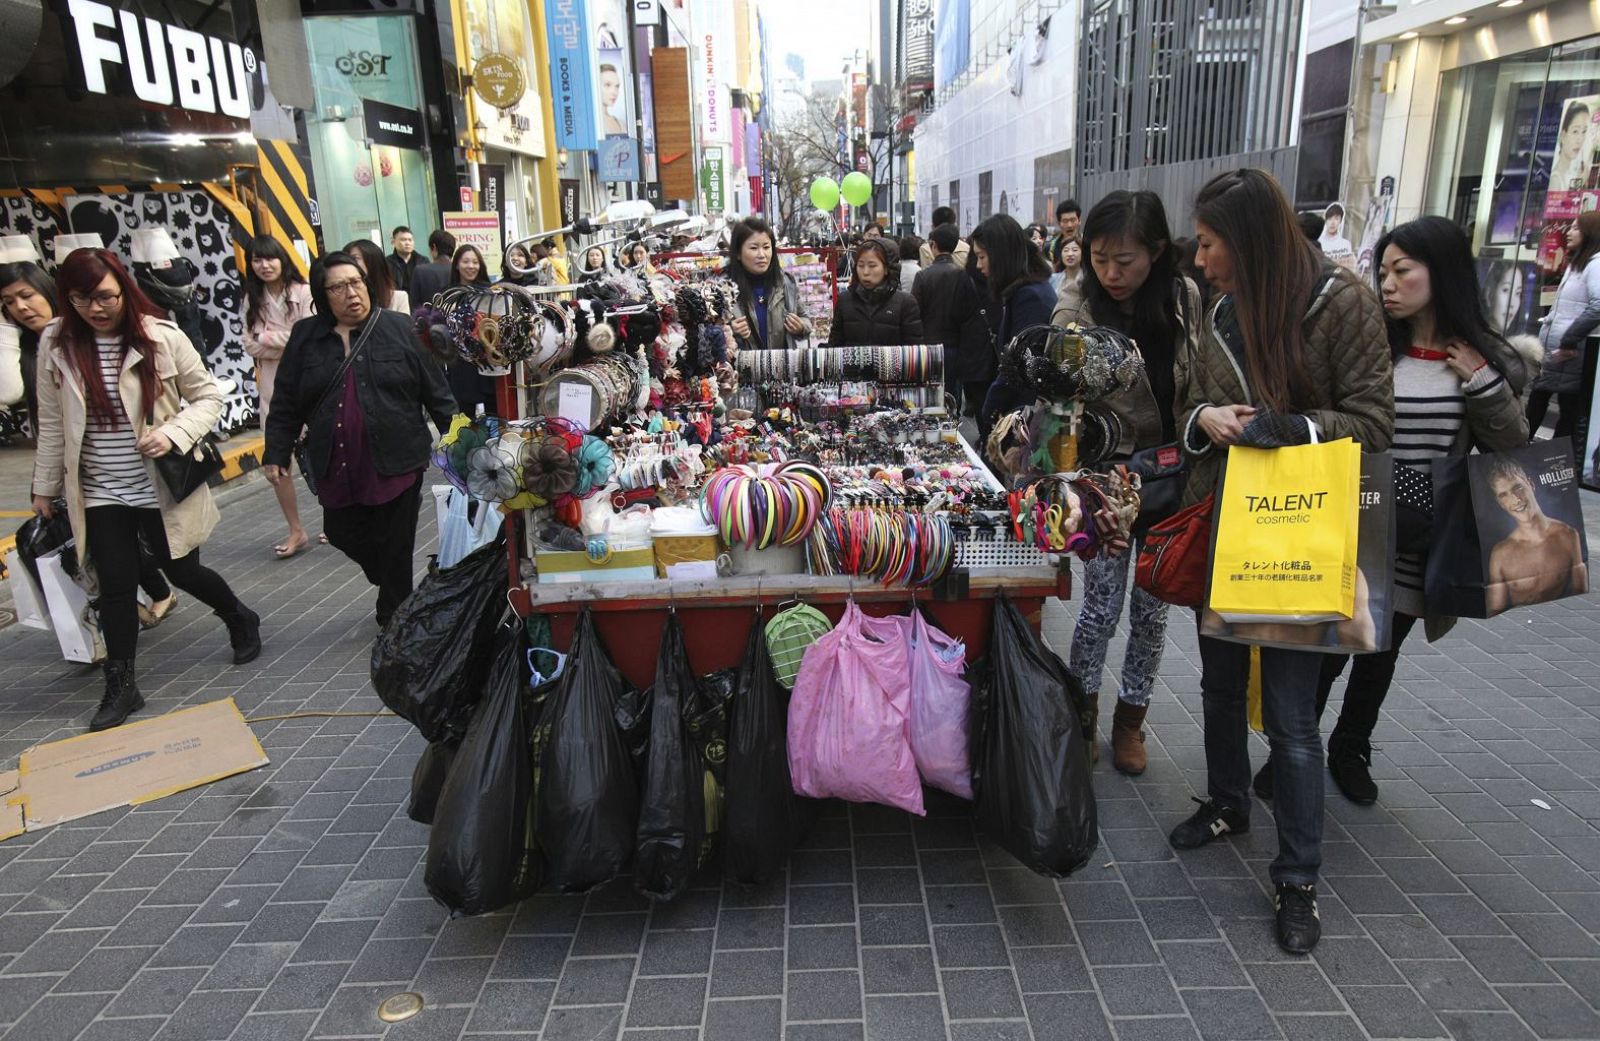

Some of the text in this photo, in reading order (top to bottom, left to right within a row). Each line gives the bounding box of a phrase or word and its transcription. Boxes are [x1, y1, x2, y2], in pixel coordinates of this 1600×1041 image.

[559, 57, 571, 92] BOOKS
[564, 106, 573, 136] MEDIA
[707, 89, 717, 133] DONUTS
[1245, 491, 1328, 513] TALENT
[1256, 514, 1311, 525] cosmetic
[1242, 560, 1312, 571] タレント化粧品
